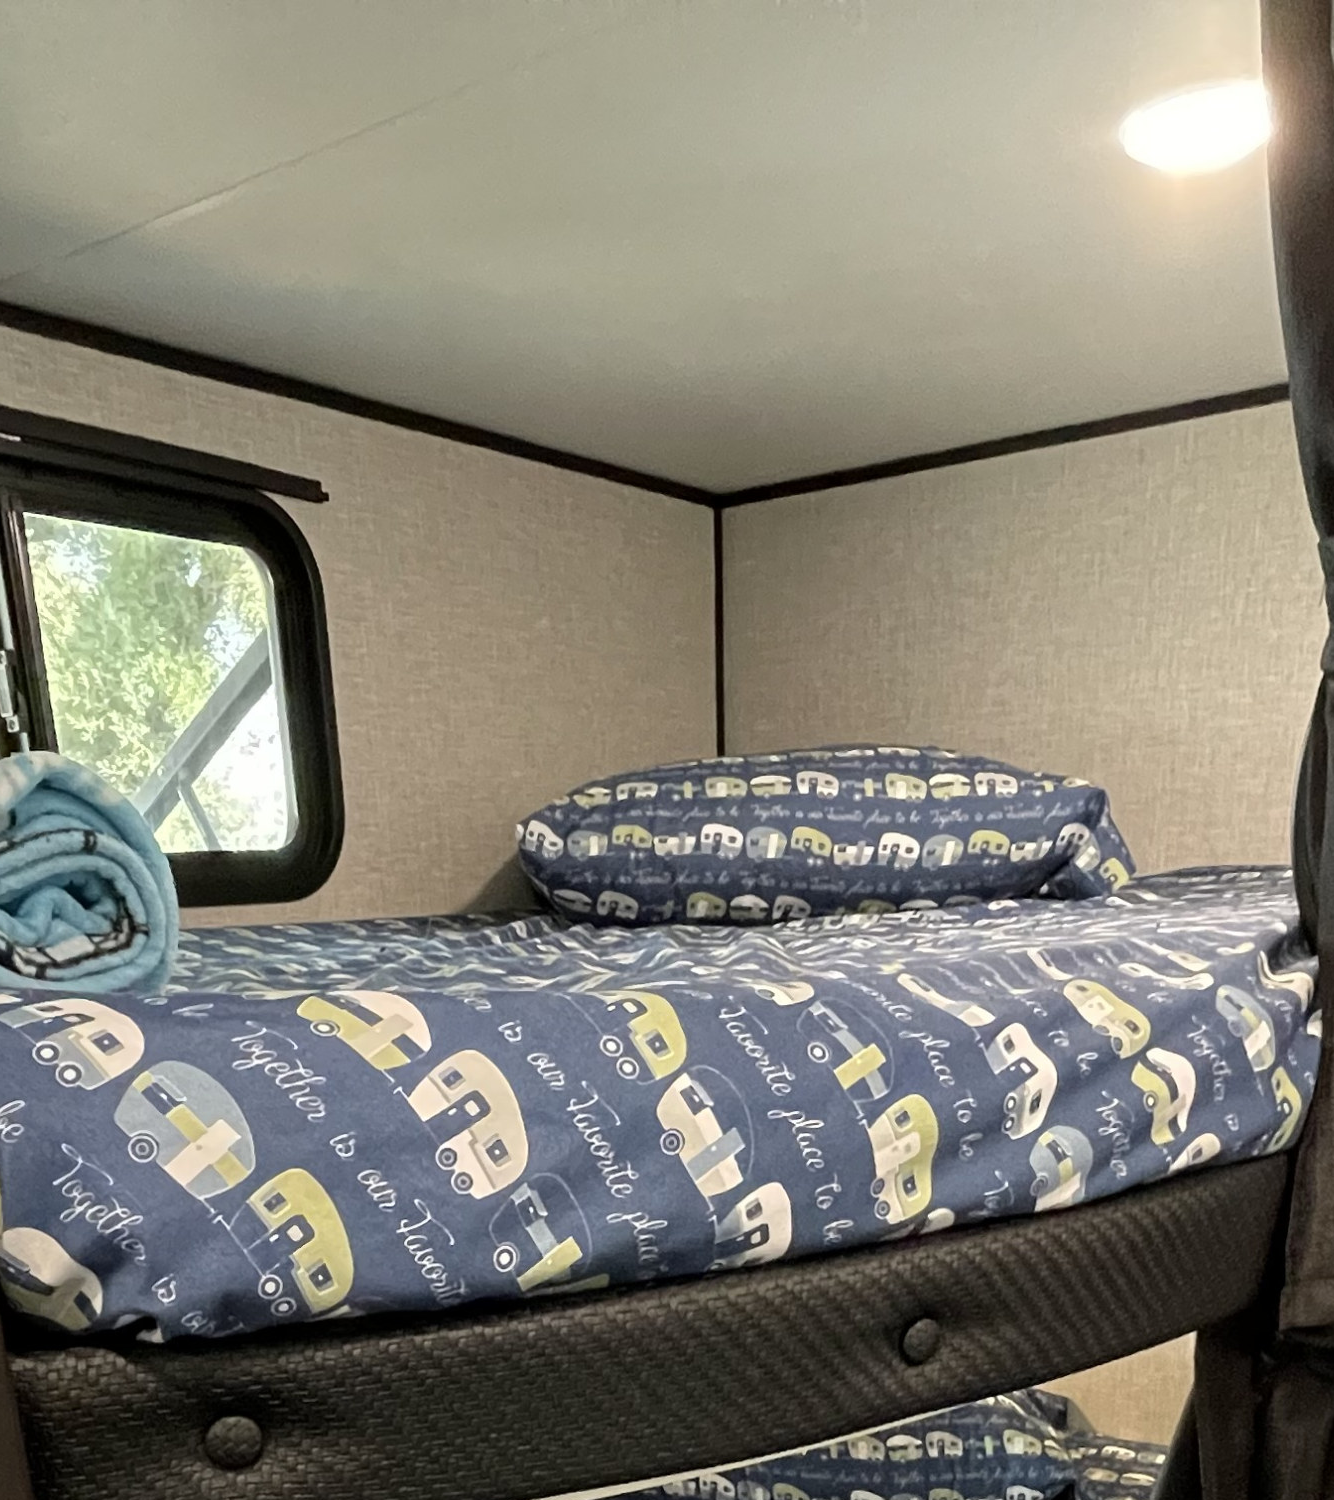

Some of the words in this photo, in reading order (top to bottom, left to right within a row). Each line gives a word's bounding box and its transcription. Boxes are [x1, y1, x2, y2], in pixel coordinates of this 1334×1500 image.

[498, 1021, 522, 1043] is
[527, 1052, 566, 1092] our
[899, 1028, 955, 1088] place
[231, 1021, 327, 1122] Together
[330, 1132, 356, 1158] is
[358, 1170, 396, 1212] our
[396, 1199, 467, 1302] Favorit
[767, 1109, 824, 1173] place
[53, 1143, 146, 1266] Together
[152, 1275, 177, 1304] is
